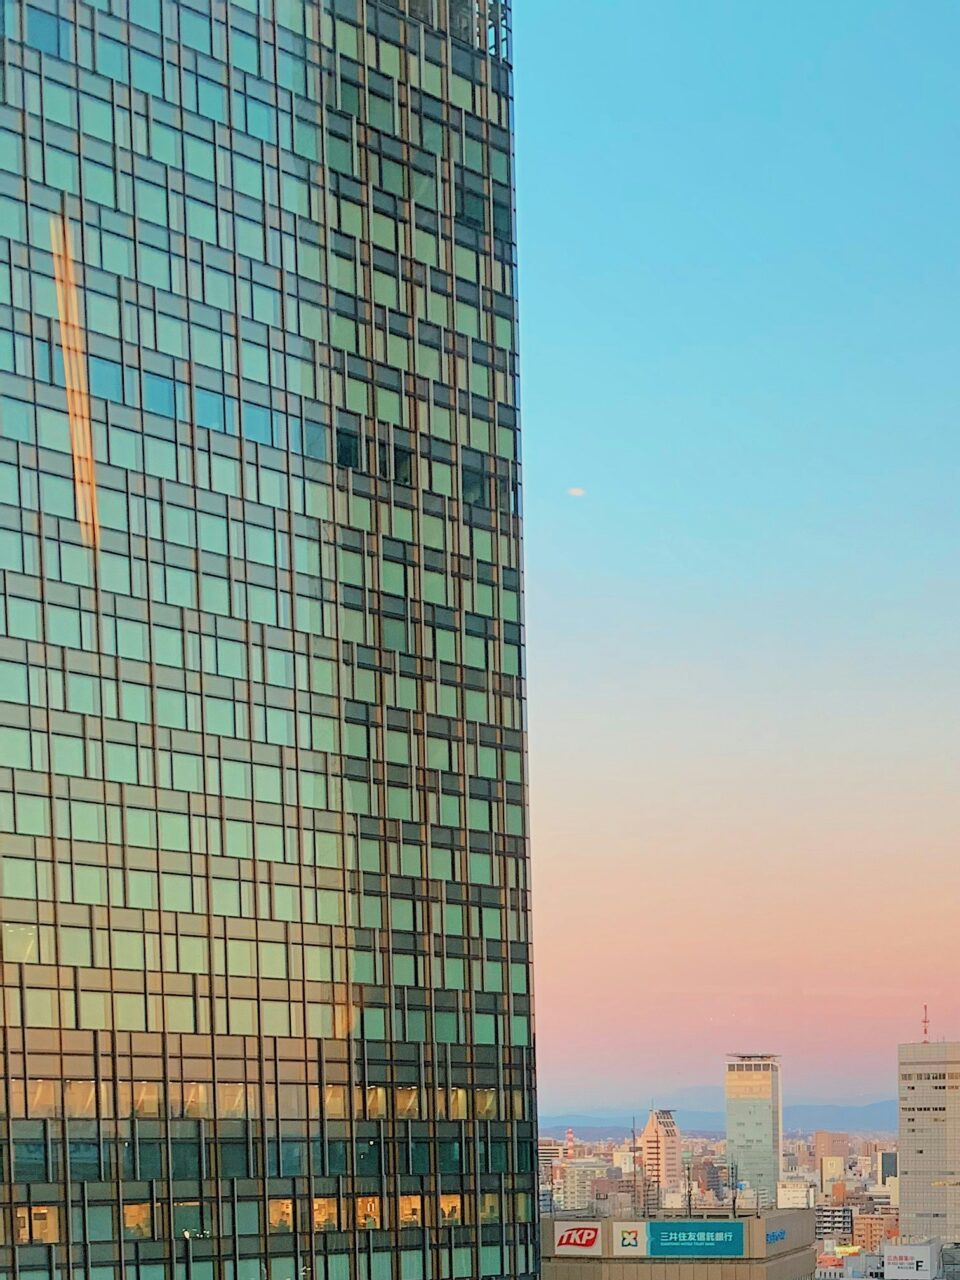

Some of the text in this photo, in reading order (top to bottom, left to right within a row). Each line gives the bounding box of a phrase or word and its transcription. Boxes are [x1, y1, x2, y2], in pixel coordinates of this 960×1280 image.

[559, 1227, 597, 1246] TKP
[660, 1231, 733, 1242] 三井住友信託銀行
